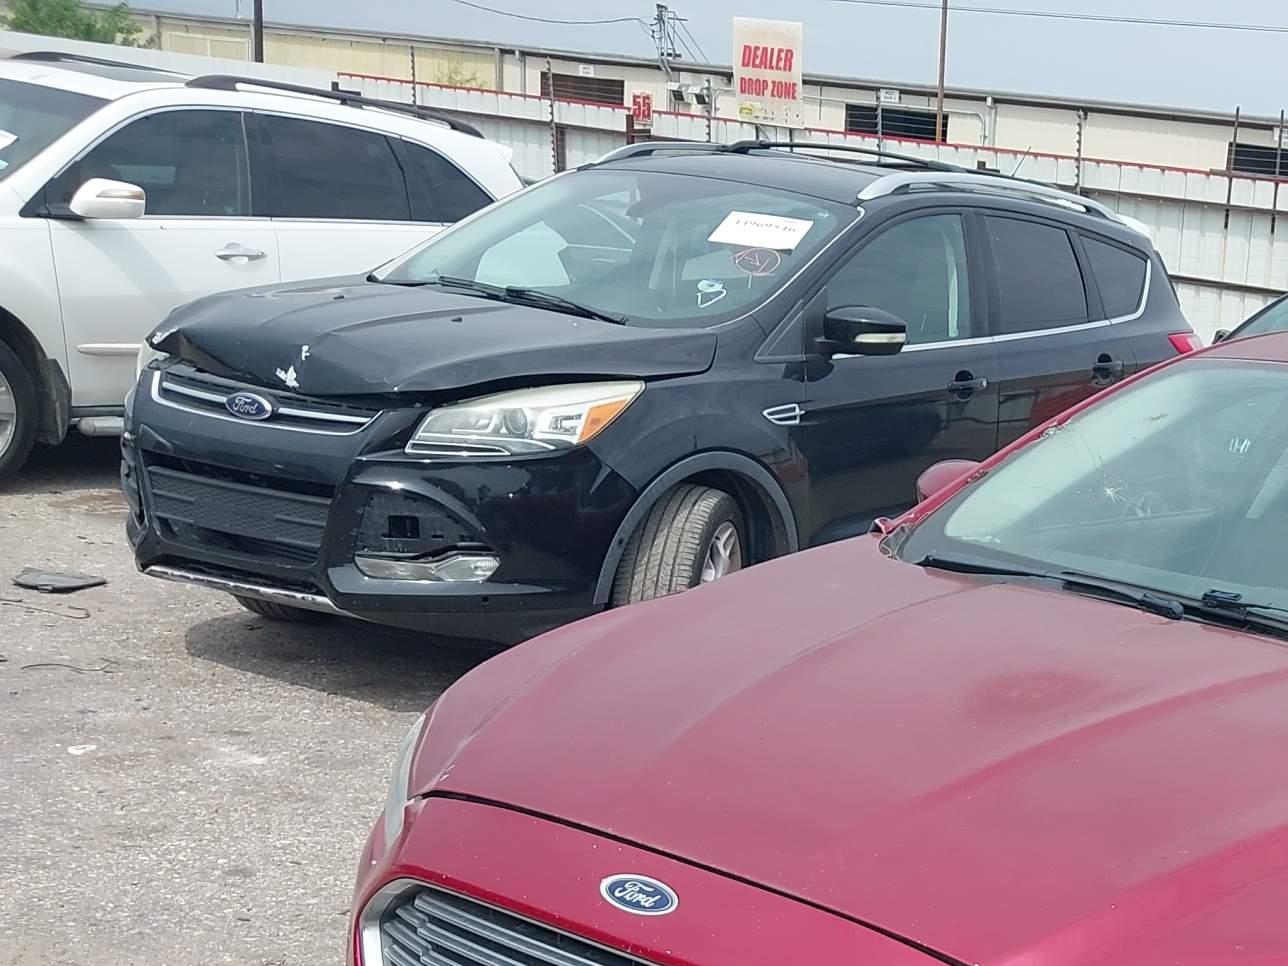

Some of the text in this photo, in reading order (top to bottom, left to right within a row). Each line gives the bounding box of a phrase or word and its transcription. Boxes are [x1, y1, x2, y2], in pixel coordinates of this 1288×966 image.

[741, 45, 794, 72] DEALER
[740, 77, 797, 100] DROP ZONE
[632, 95, 651, 120] 55
[232, 396, 258, 414] Ford
[614, 880, 662, 908] Ford
